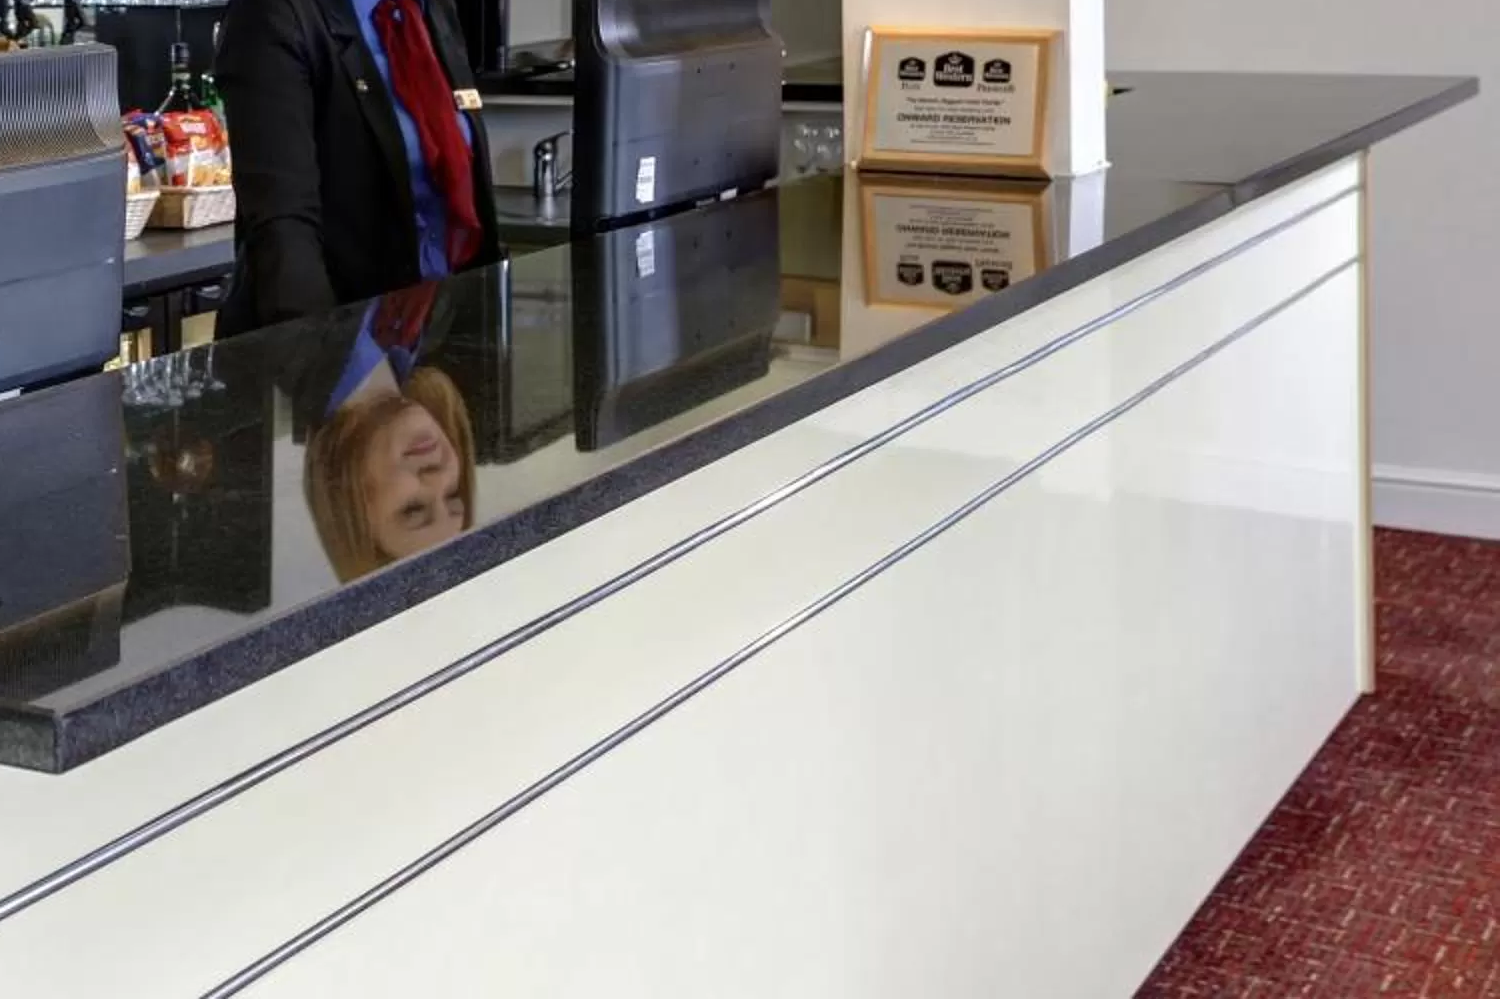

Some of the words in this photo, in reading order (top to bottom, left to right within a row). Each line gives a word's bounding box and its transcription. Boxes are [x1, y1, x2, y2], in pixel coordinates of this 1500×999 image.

[943, 63, 964, 74] Best
[935, 73, 973, 82] Western
[896, 112, 940, 123] ONWARD
